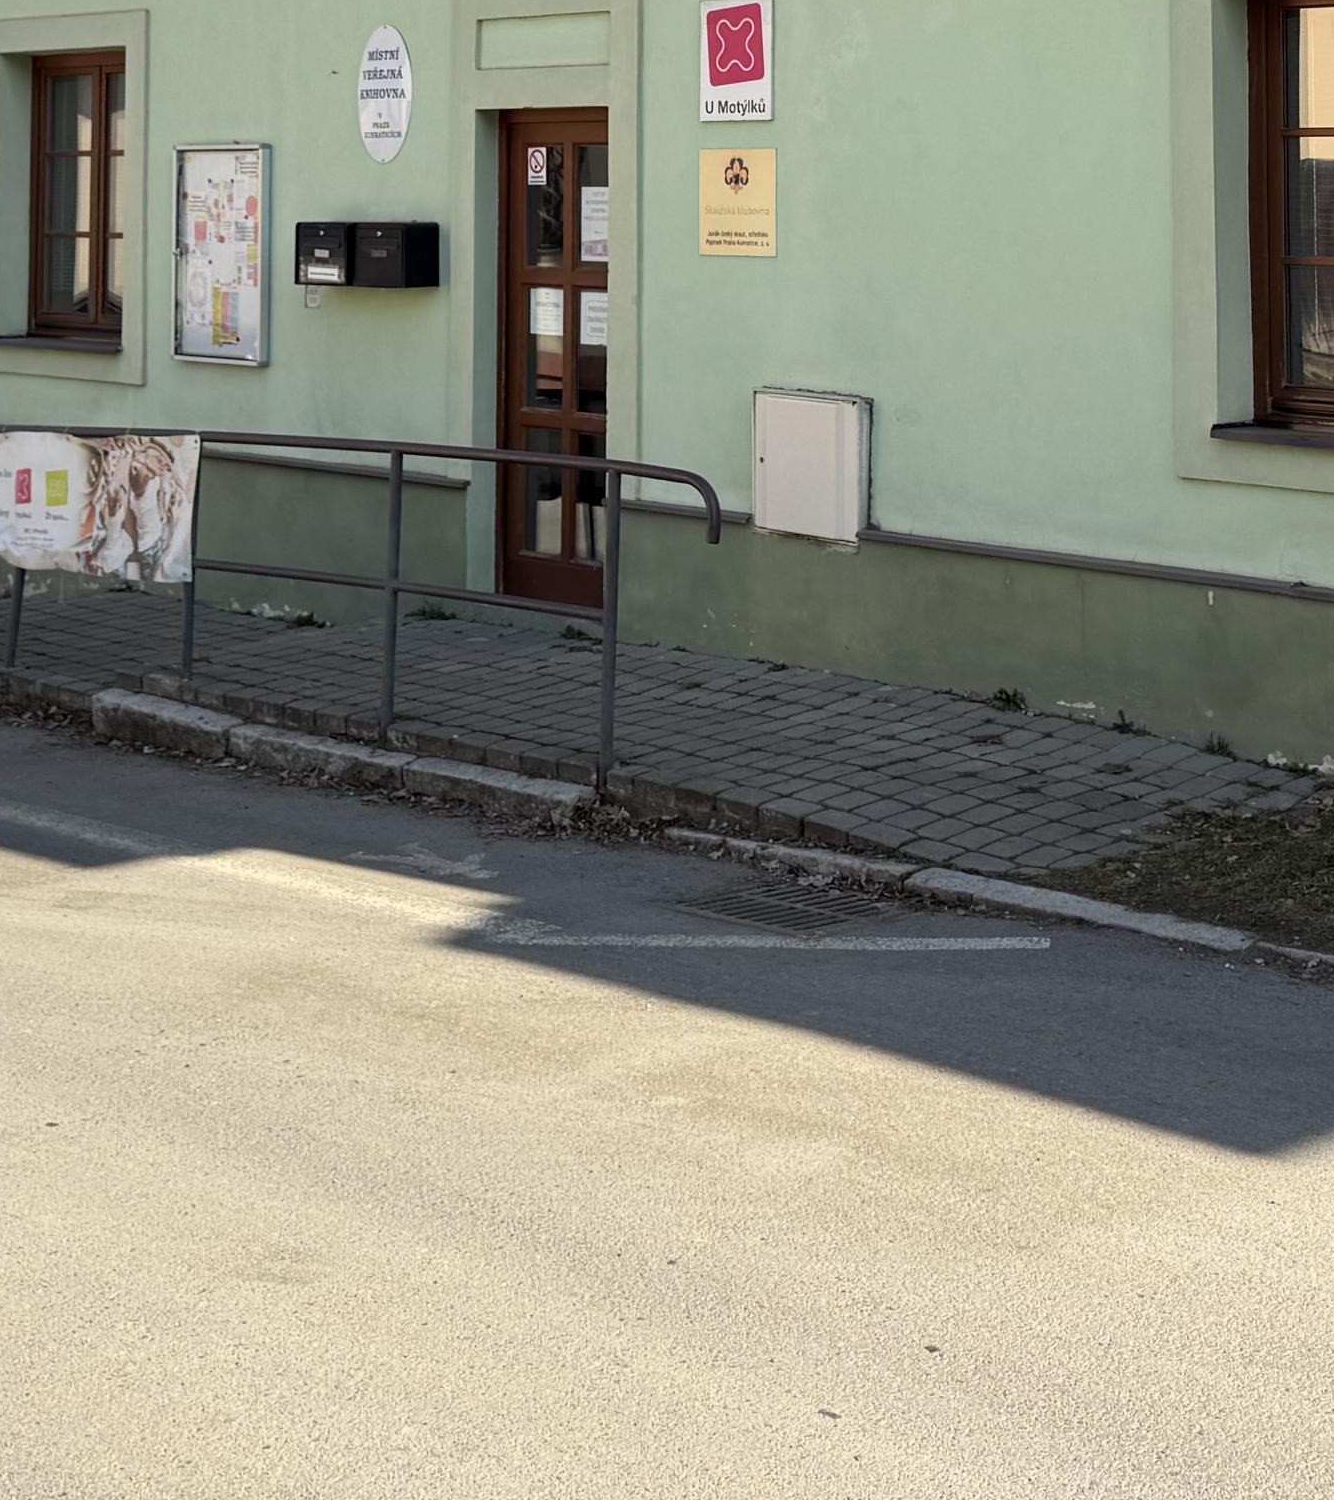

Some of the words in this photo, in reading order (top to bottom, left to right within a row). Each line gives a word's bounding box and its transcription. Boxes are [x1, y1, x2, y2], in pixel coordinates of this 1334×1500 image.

[367, 47, 400, 61] MÍSTNÍ
[363, 65, 403, 80] VEŘEJNÁ
[360, 88, 406, 100] KNIHOVNA
[705, 101, 714, 114] U
[717, 98, 766, 116] Motýlků
